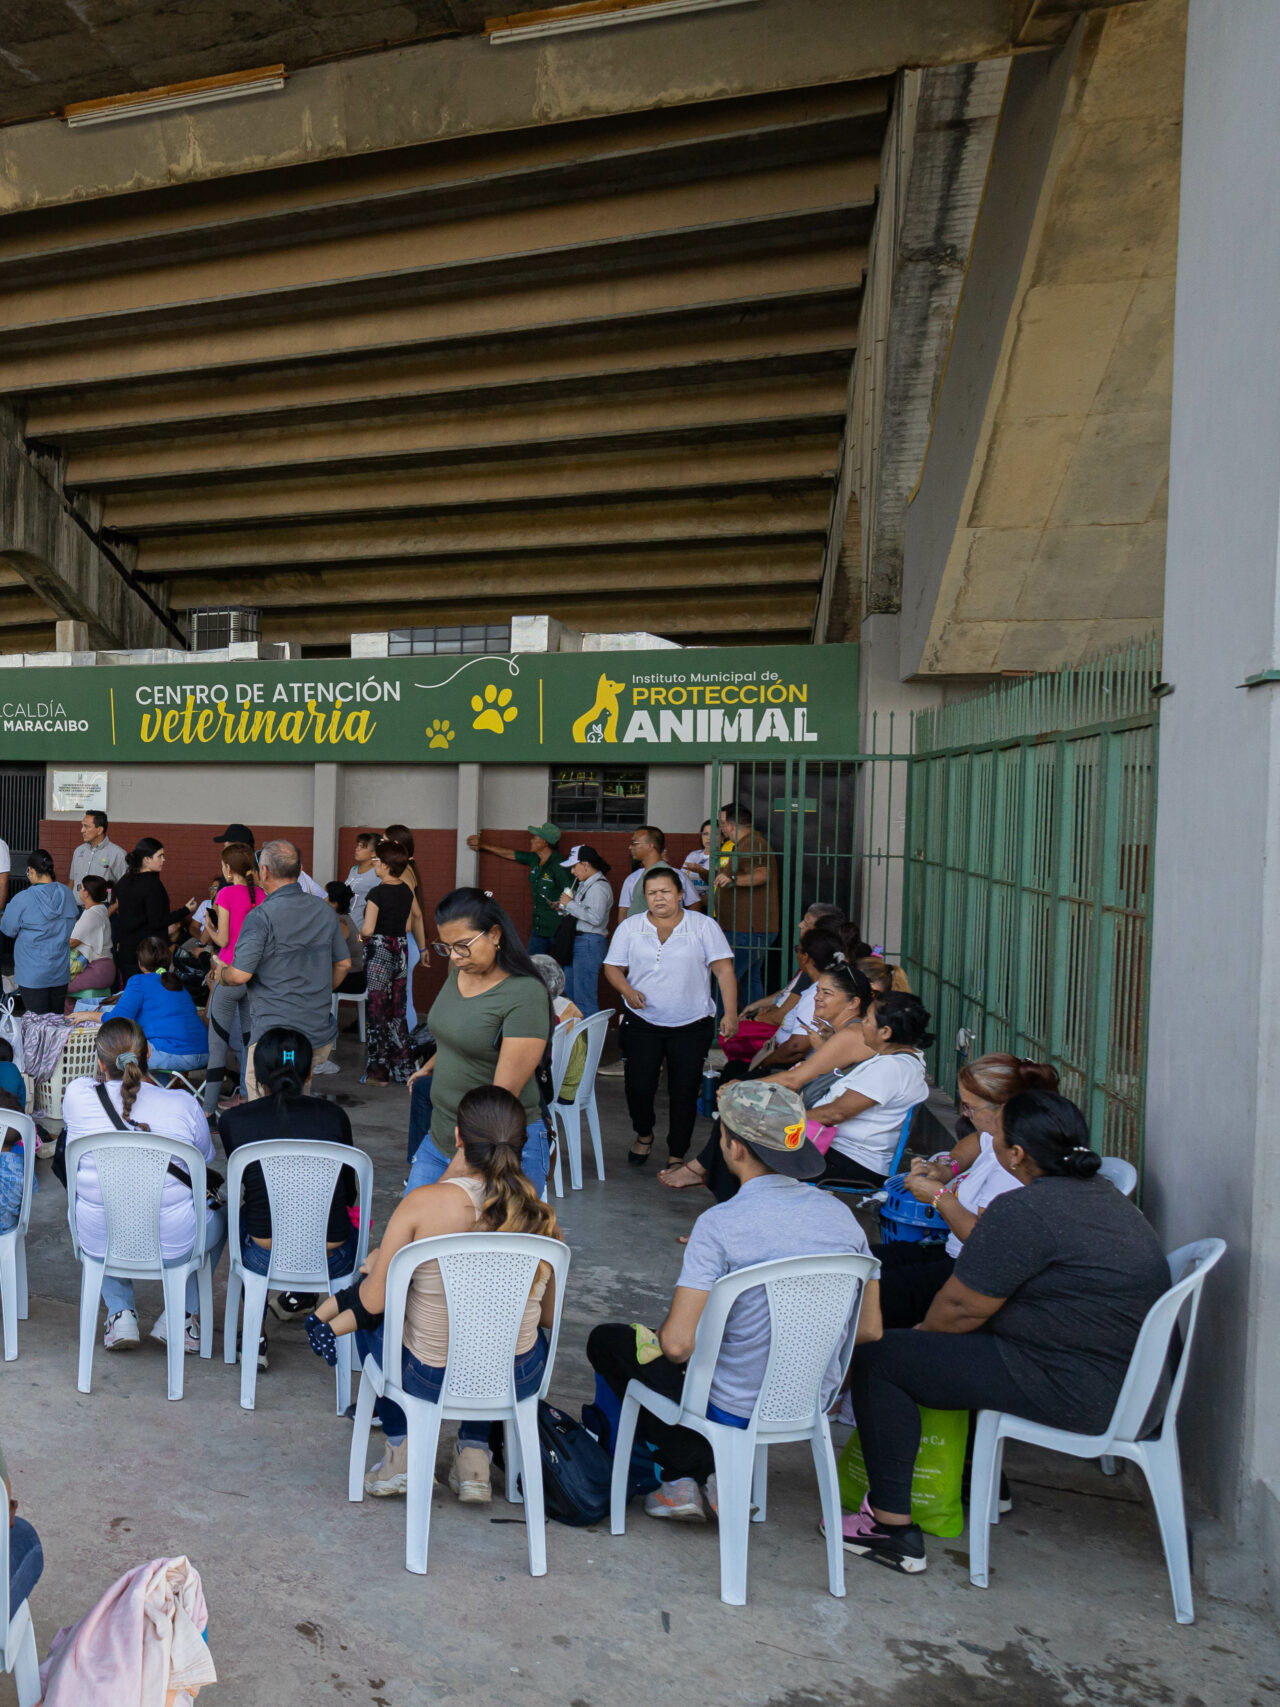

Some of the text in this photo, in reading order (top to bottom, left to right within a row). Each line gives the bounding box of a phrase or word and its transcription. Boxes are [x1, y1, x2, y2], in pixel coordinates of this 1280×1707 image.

[135, 675, 401, 705] CENTRO DE ATENCIÓN
[632, 670, 779, 685] Instituto Municipal de
[632, 679, 808, 706] PROTECCIÓN
[4, 720, 89, 732] MARACAIBO
[140, 694, 377, 744] veterinaria
[622, 707, 818, 743] ANIMAL
